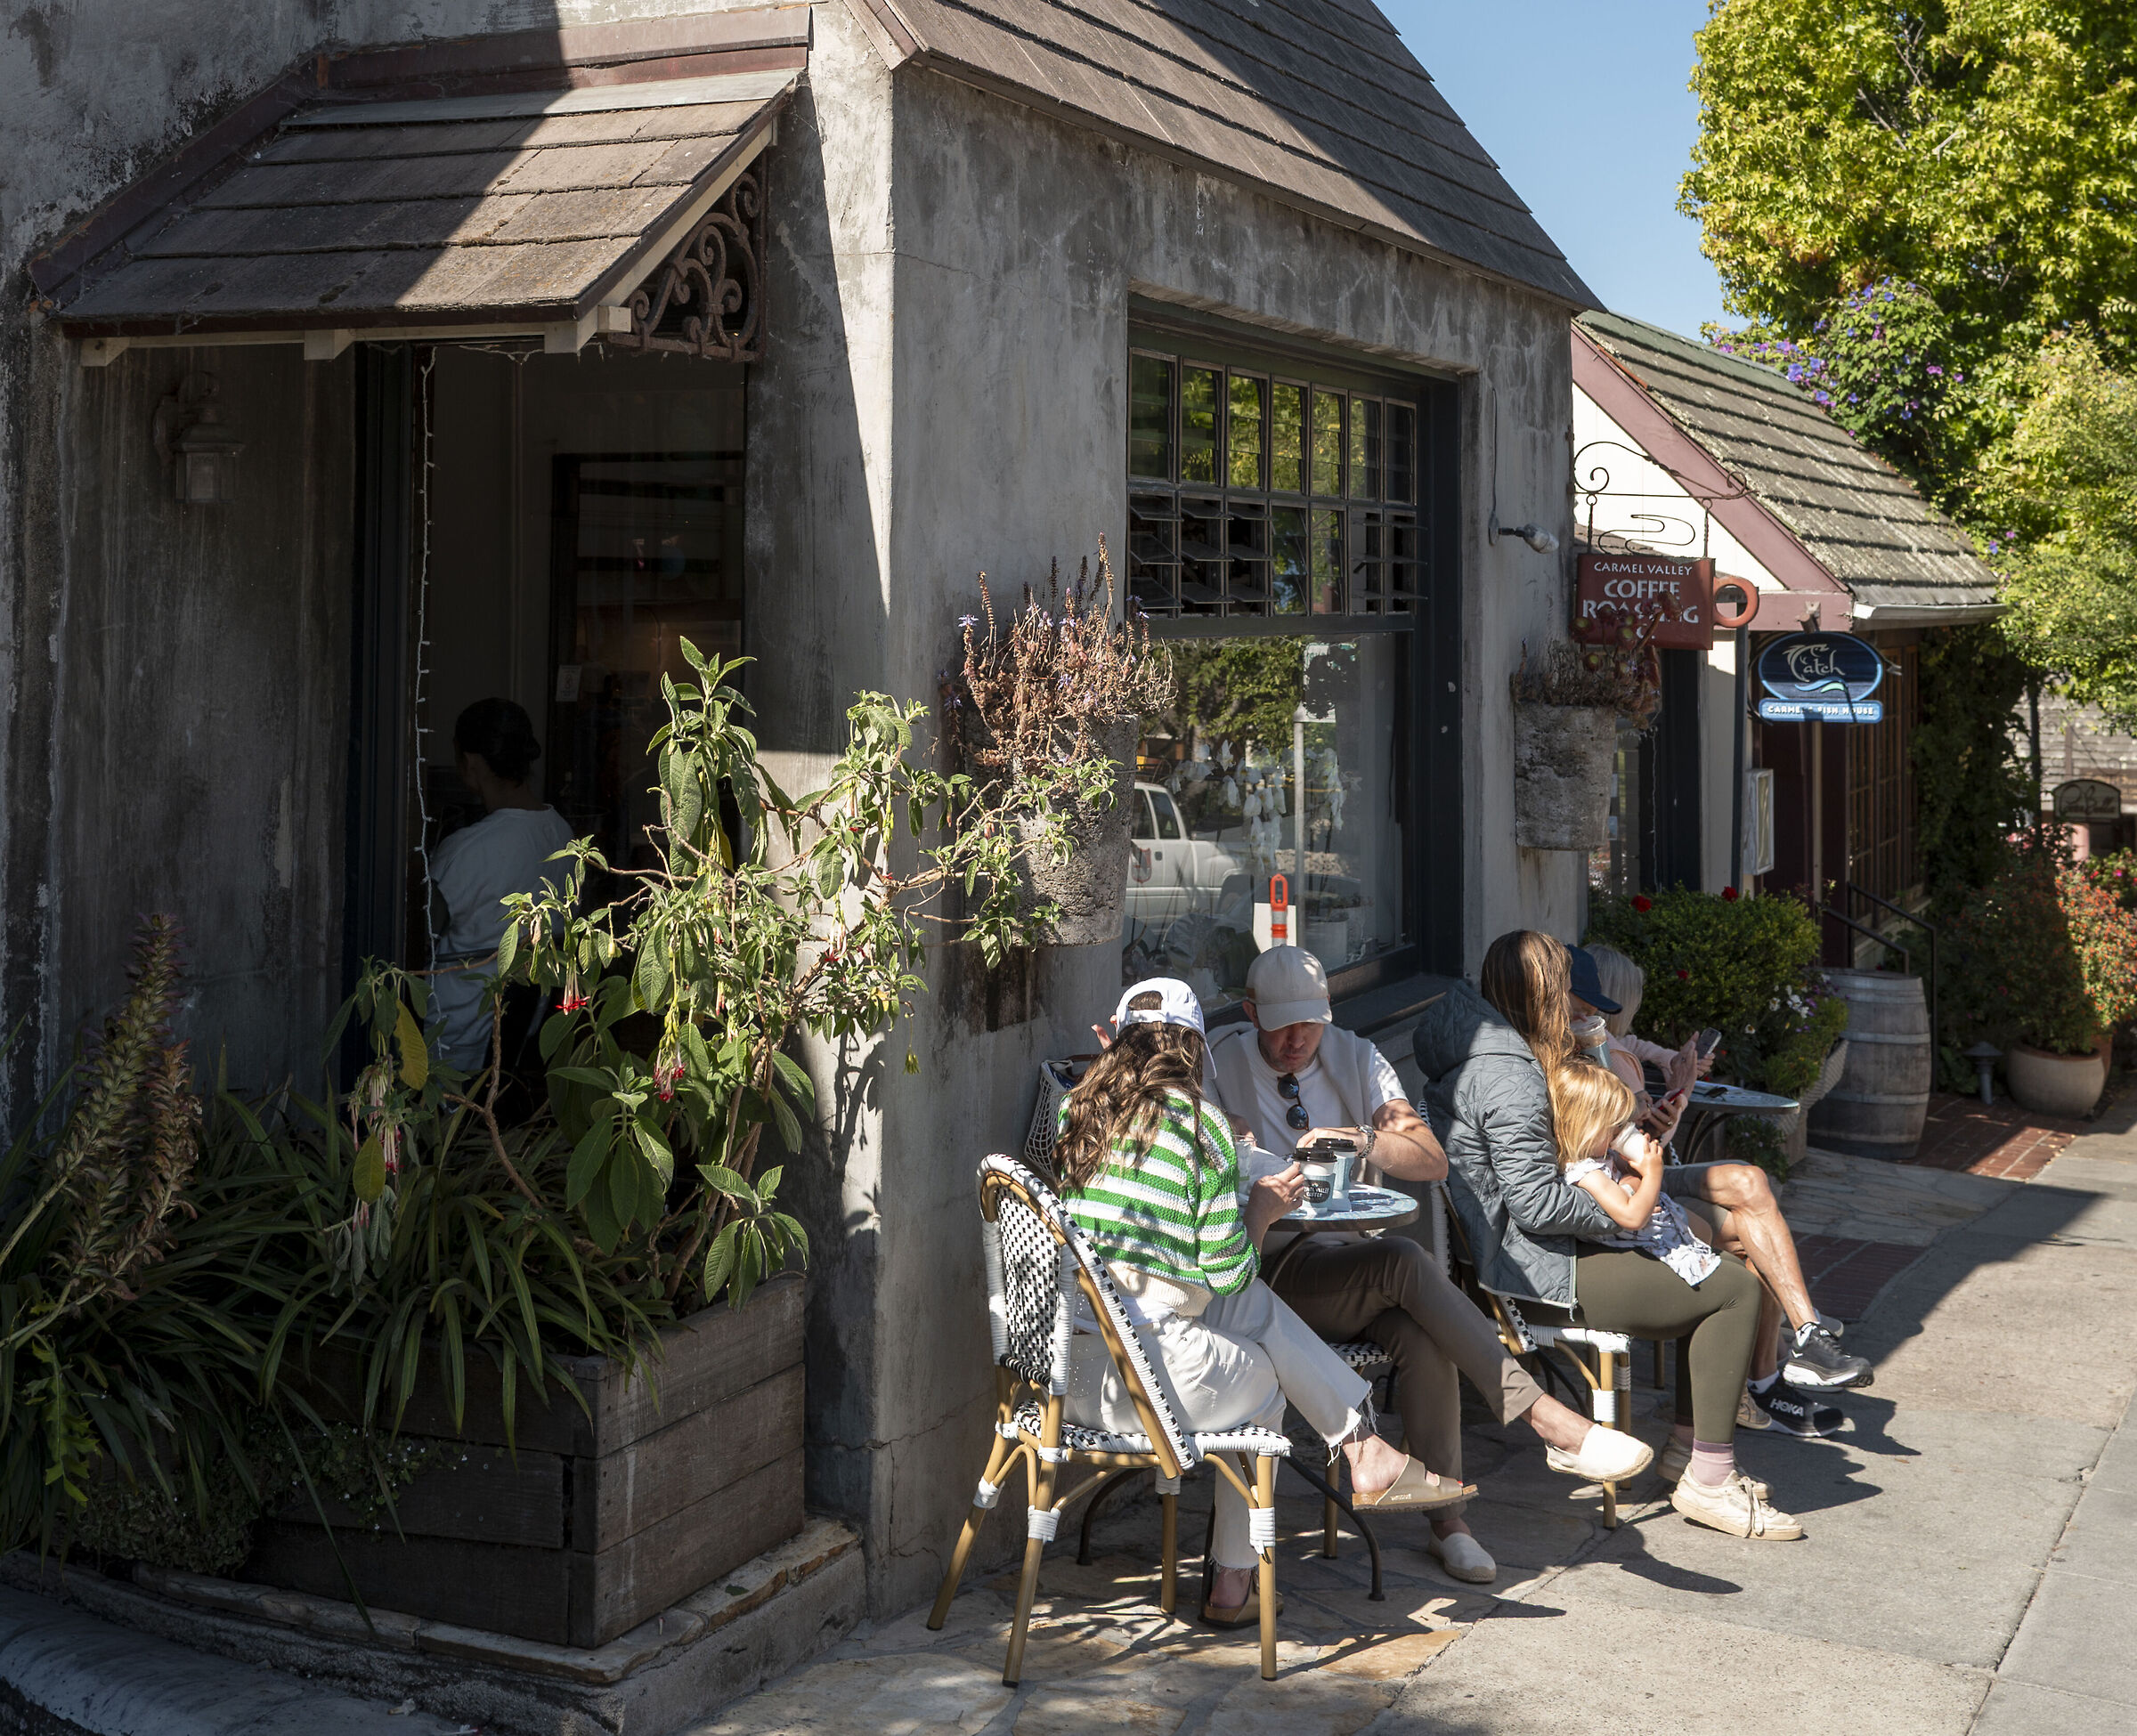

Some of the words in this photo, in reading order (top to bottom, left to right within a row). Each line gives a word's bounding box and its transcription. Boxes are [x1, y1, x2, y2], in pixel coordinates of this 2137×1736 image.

[1594, 562, 1644, 573] CARMEL
[1646, 564, 1693, 576] VALLEY
[1604, 579, 1680, 600] COFFEE
[1782, 644, 1845, 683] Catch
[1817, 707, 1839, 715] FISH
[1769, 1398, 1804, 1417] HOKA
